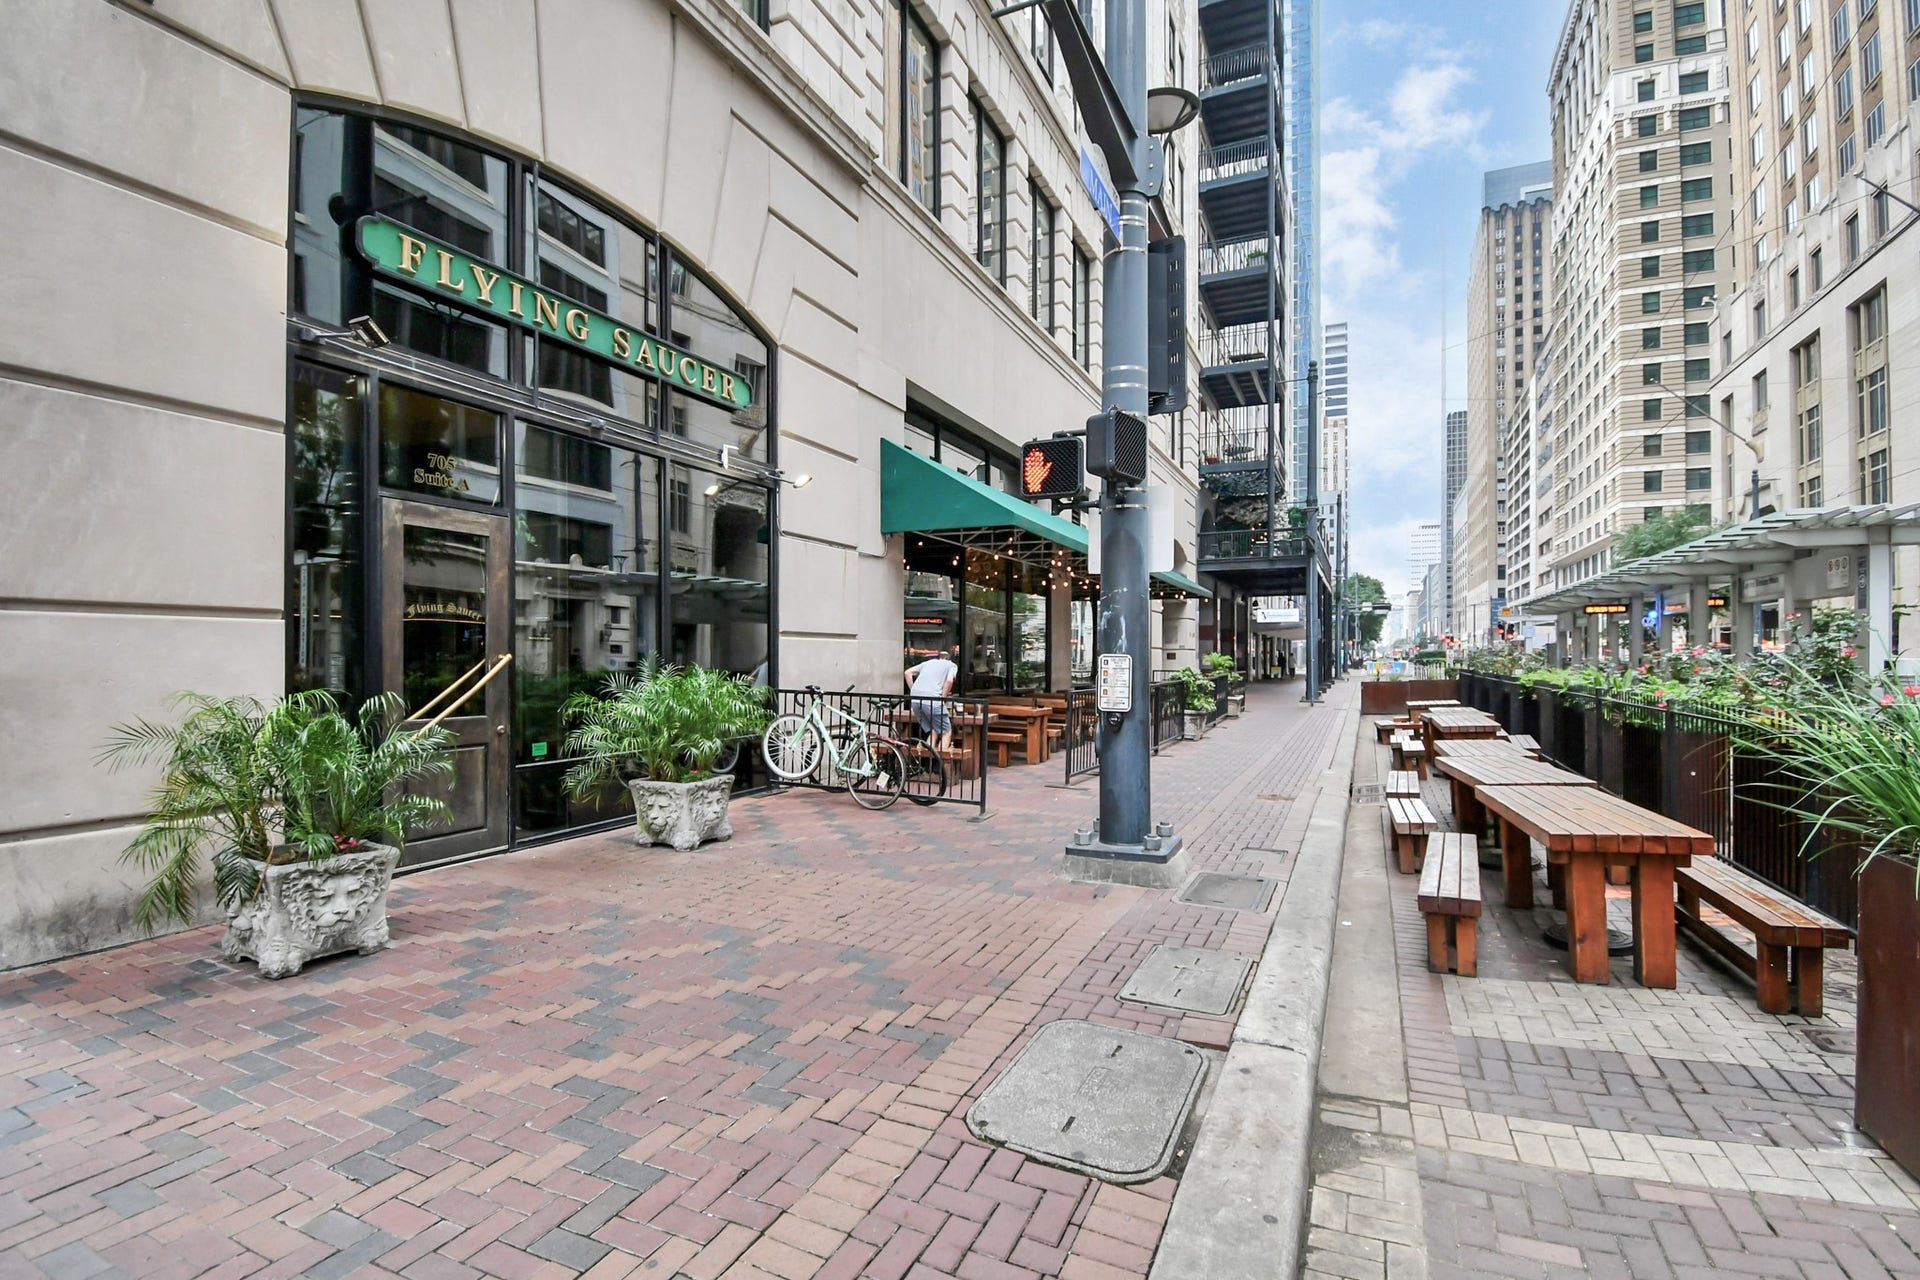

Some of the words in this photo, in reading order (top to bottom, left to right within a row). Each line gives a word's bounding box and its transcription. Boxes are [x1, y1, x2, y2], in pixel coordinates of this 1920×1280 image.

[397, 233, 590, 341] FLYING
[613, 327, 738, 403] SAUCER
[427, 452, 456, 471] 705
[413, 467, 455, 489] Suite
[458, 477, 470, 491] A
[407, 602, 444, 618] Flying
[446, 602, 483, 621] Saucer
